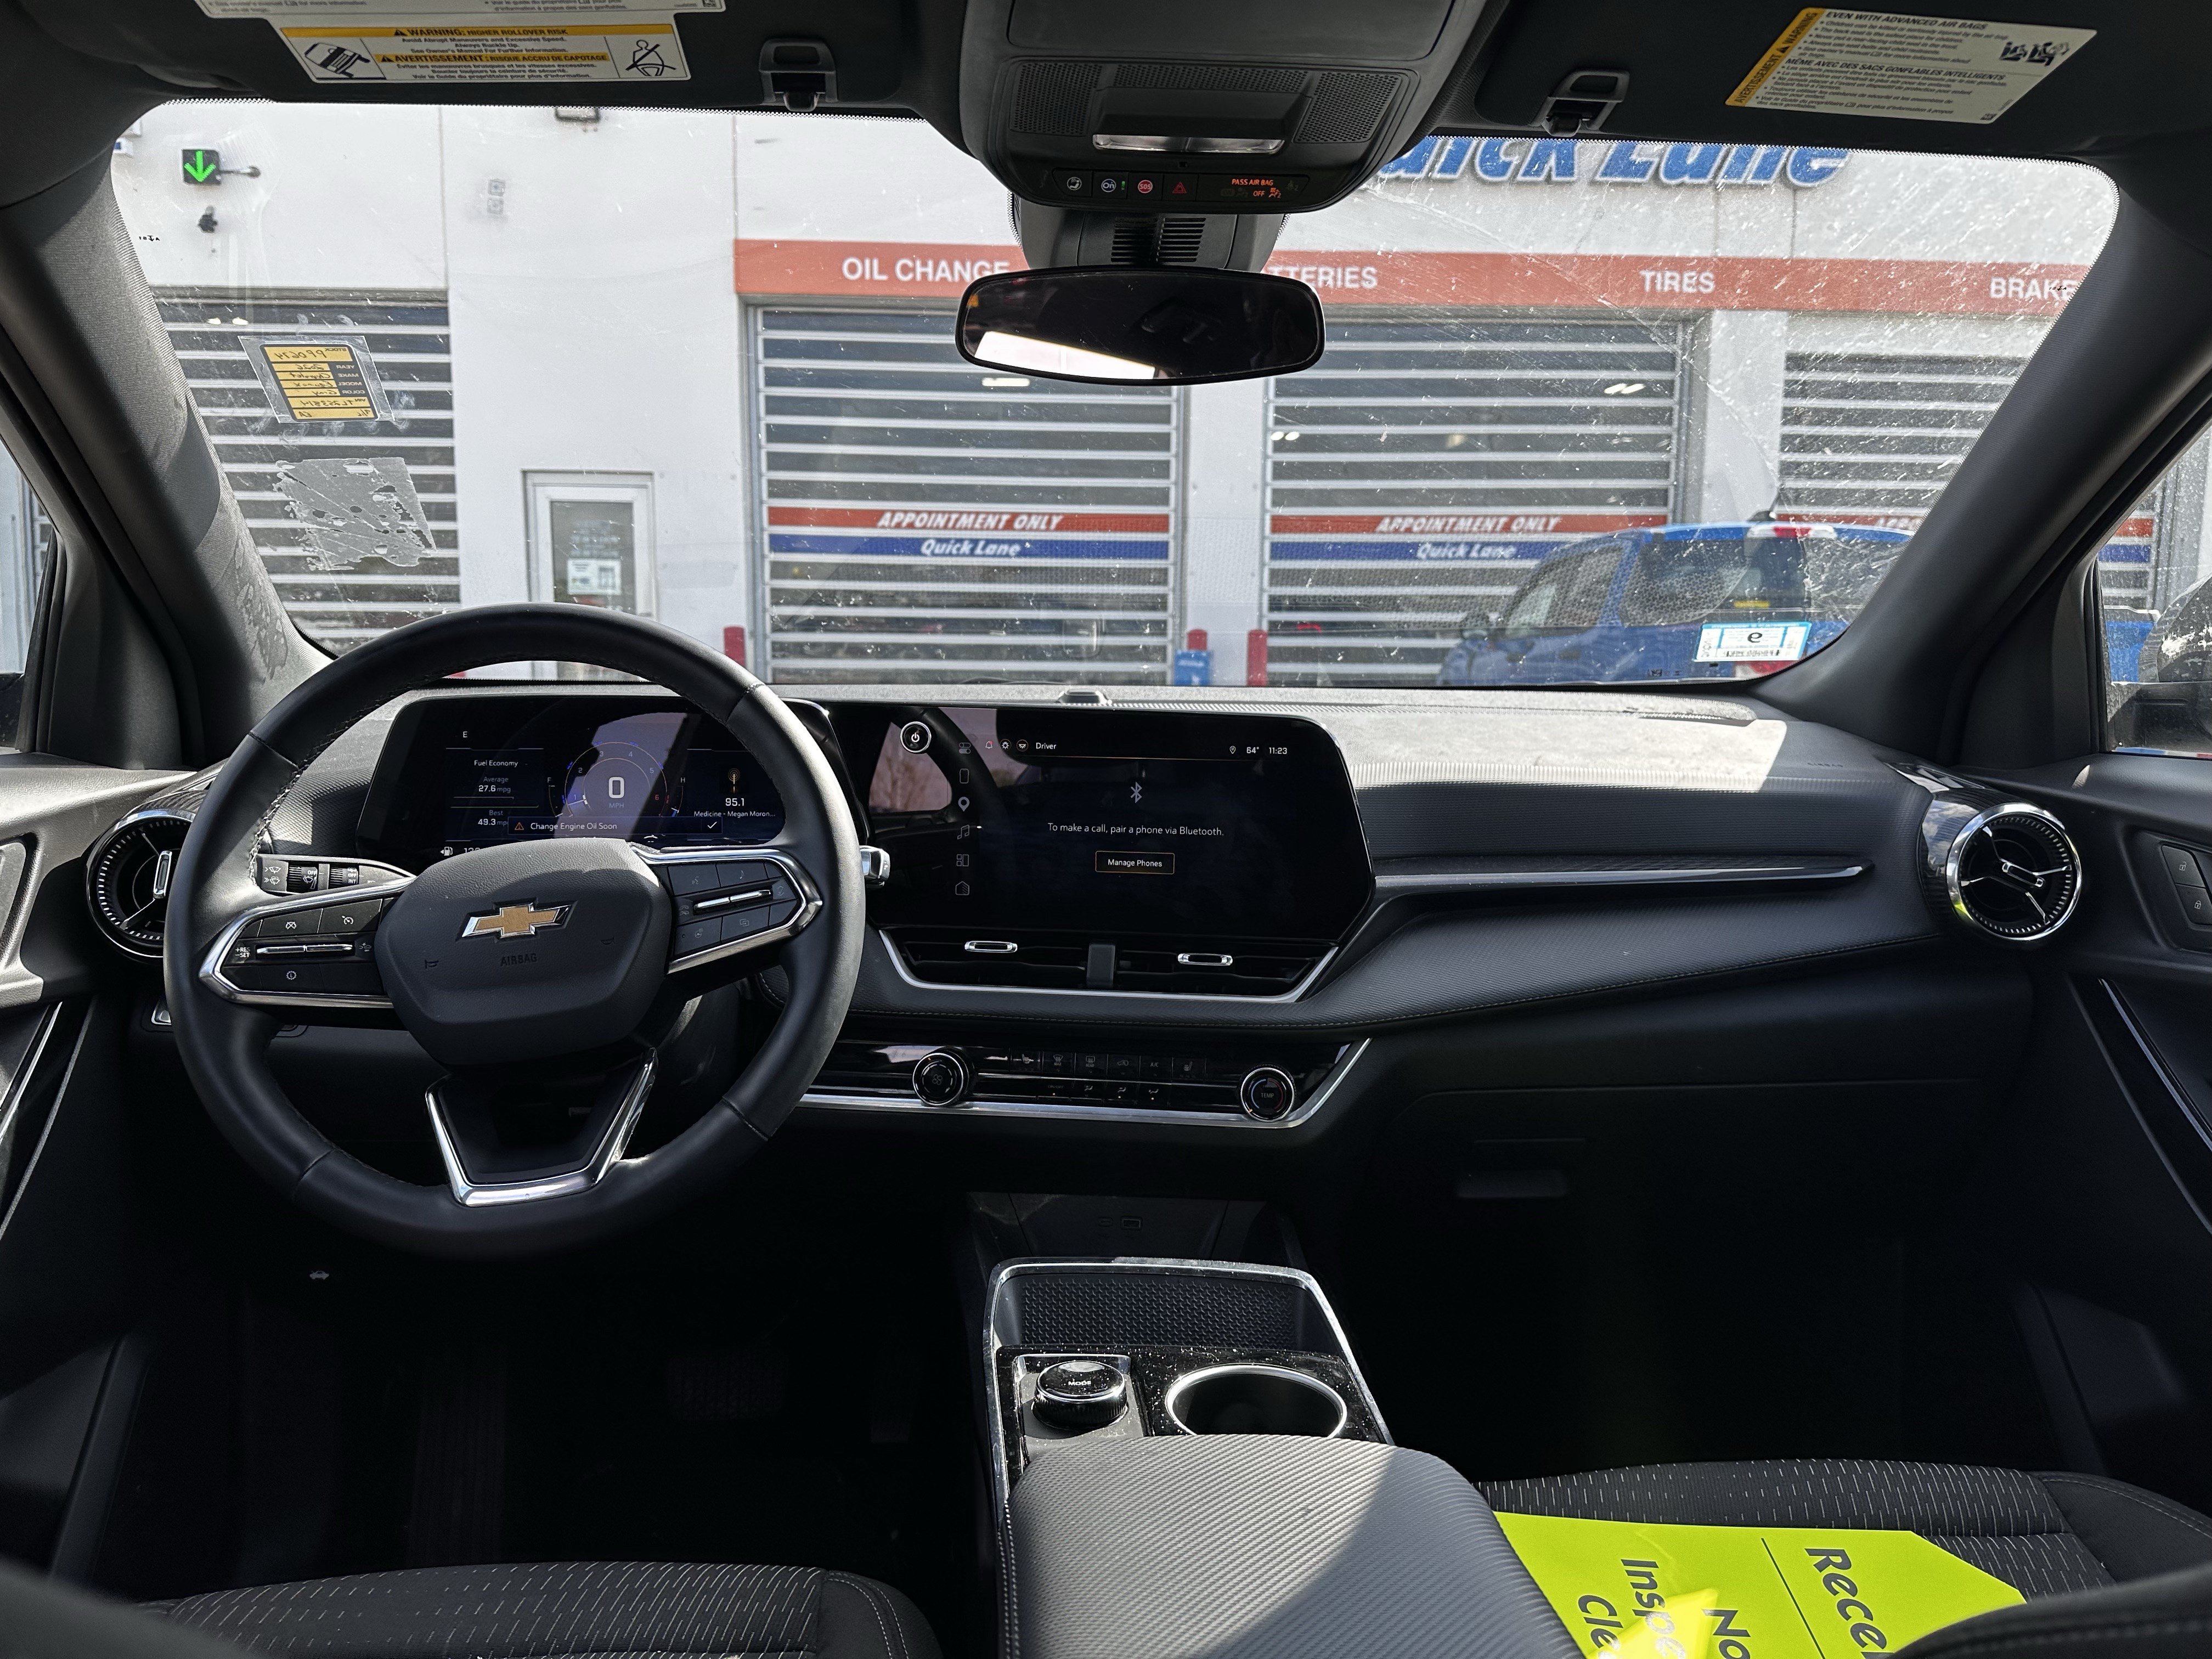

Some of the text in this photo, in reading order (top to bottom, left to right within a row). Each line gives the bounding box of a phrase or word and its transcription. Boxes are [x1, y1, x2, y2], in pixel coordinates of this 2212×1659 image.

[1854, 13, 1882, 21] WITH
[1882, 15, 1938, 26] ADVANCED
[1378, 136, 1577, 180] uick
[842, 256, 888, 281] OIL
[1267, 266, 1379, 289] TTERIES
[1639, 269, 1716, 294] TIRES
[877, 511, 1064, 531] APPOINTMENT ONLY
[1375, 515, 1562, 533] APPOINTMENT ONLY
[921, 538, 1020, 557] Quick Lane
[1416, 540, 1517, 559] Quick Lane
[1268, 747, 1288, 755] 11:23
[725, 798, 745, 806] 95.1
[531, 822, 558, 832] Change
[560, 823, 585, 832] Engine
[1047, 822, 1058, 832] To
[1060, 823, 1082, 832] make
[1091, 824, 1108, 834] call,
[1110, 825, 1126, 835] pair
[1136, 826, 1163, 836] phone
[1165, 826, 1177, 835] via
[1180, 826, 1224, 836] Bluetooth.
[1108, 859, 1163, 868] Manage Phones
[500, 953, 537, 966] AIRBAG
